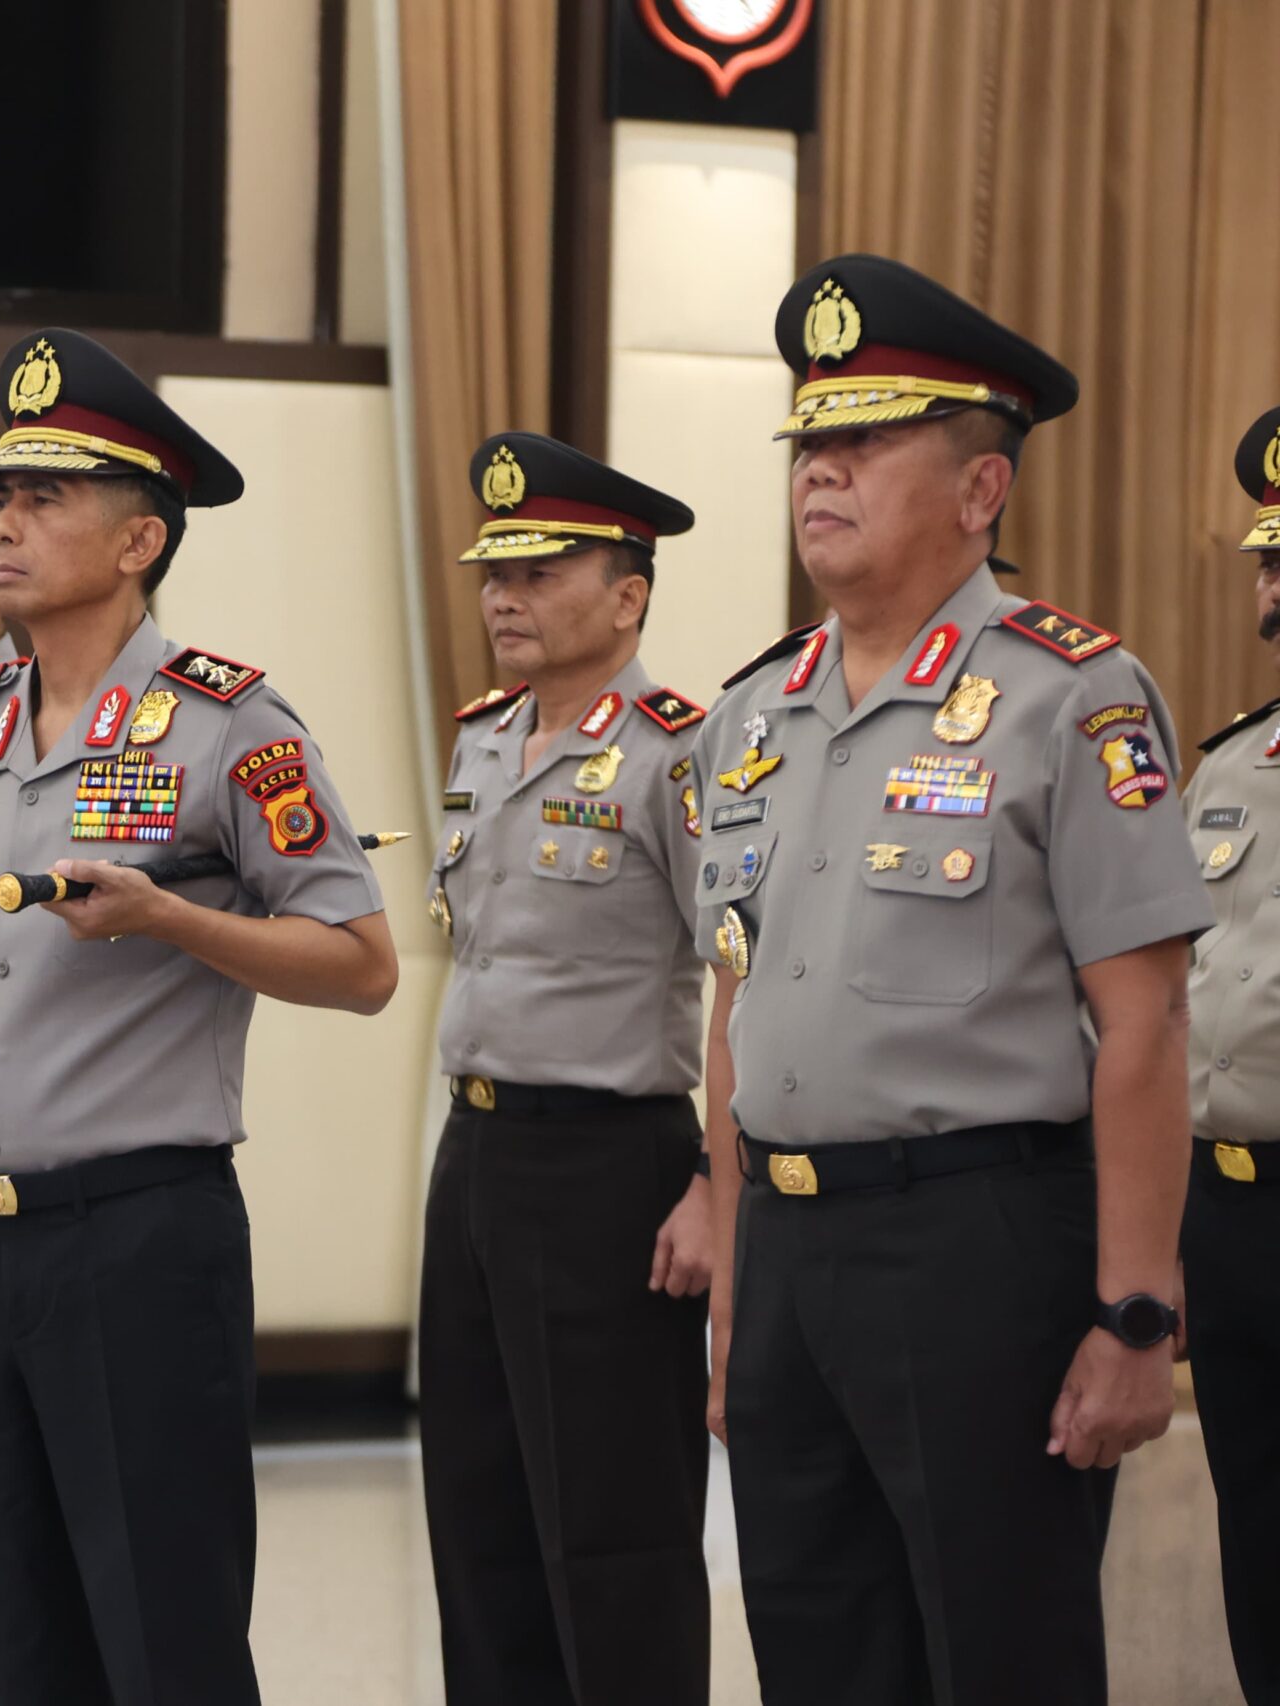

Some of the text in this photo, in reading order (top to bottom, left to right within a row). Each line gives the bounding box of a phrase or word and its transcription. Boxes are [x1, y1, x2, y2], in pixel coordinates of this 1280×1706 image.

[1084, 705, 1146, 734] LEMDIKLAT
[237, 742, 297, 780] POLDA
[259, 768, 298, 793] ACEH
[1110, 774, 1165, 800] MABES POLRI
